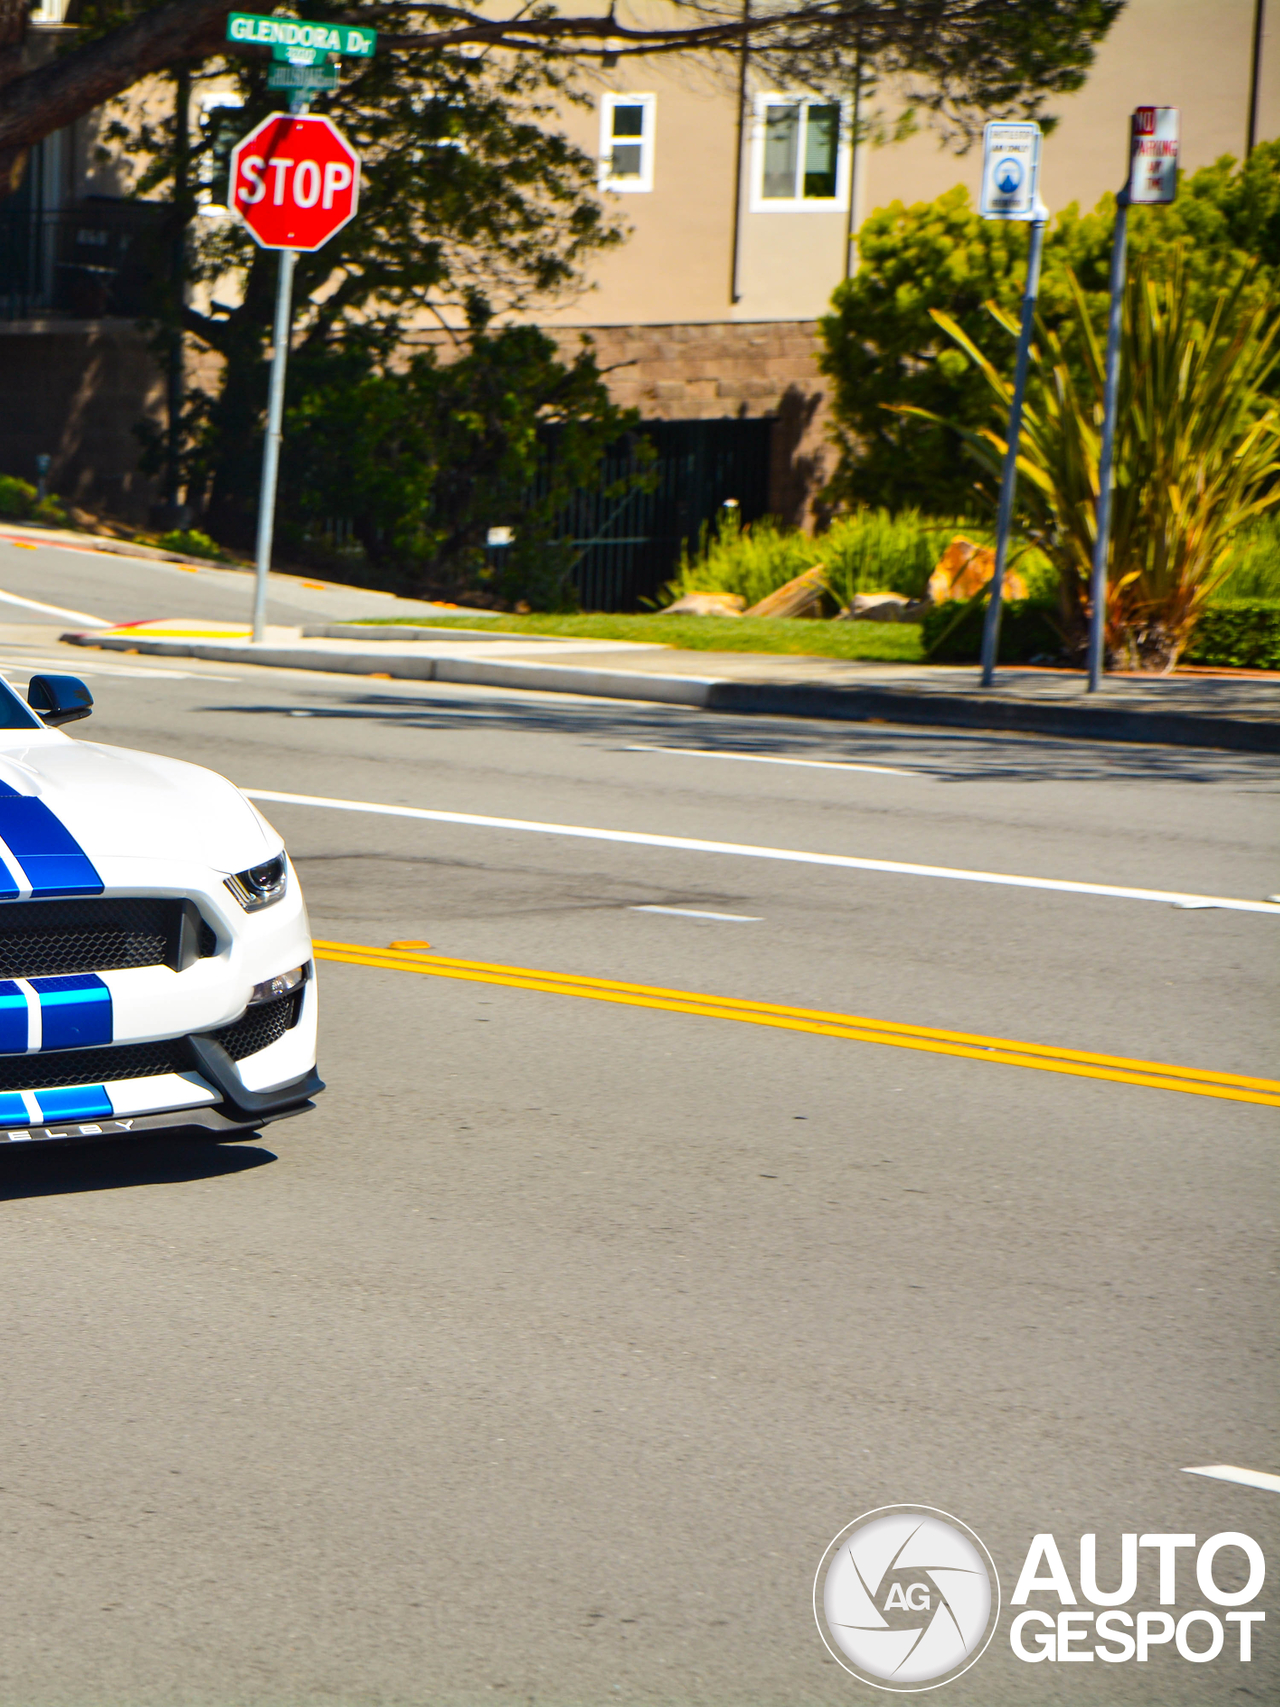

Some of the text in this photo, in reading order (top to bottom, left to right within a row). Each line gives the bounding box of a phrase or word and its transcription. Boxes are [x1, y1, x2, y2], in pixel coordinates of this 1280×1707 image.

[230, 17, 341, 50] GLENDORA
[346, 31, 372, 53] Dr
[1136, 112, 1153, 131] NO
[1133, 140, 1178, 157] PARKING
[237, 154, 352, 210] STOP
